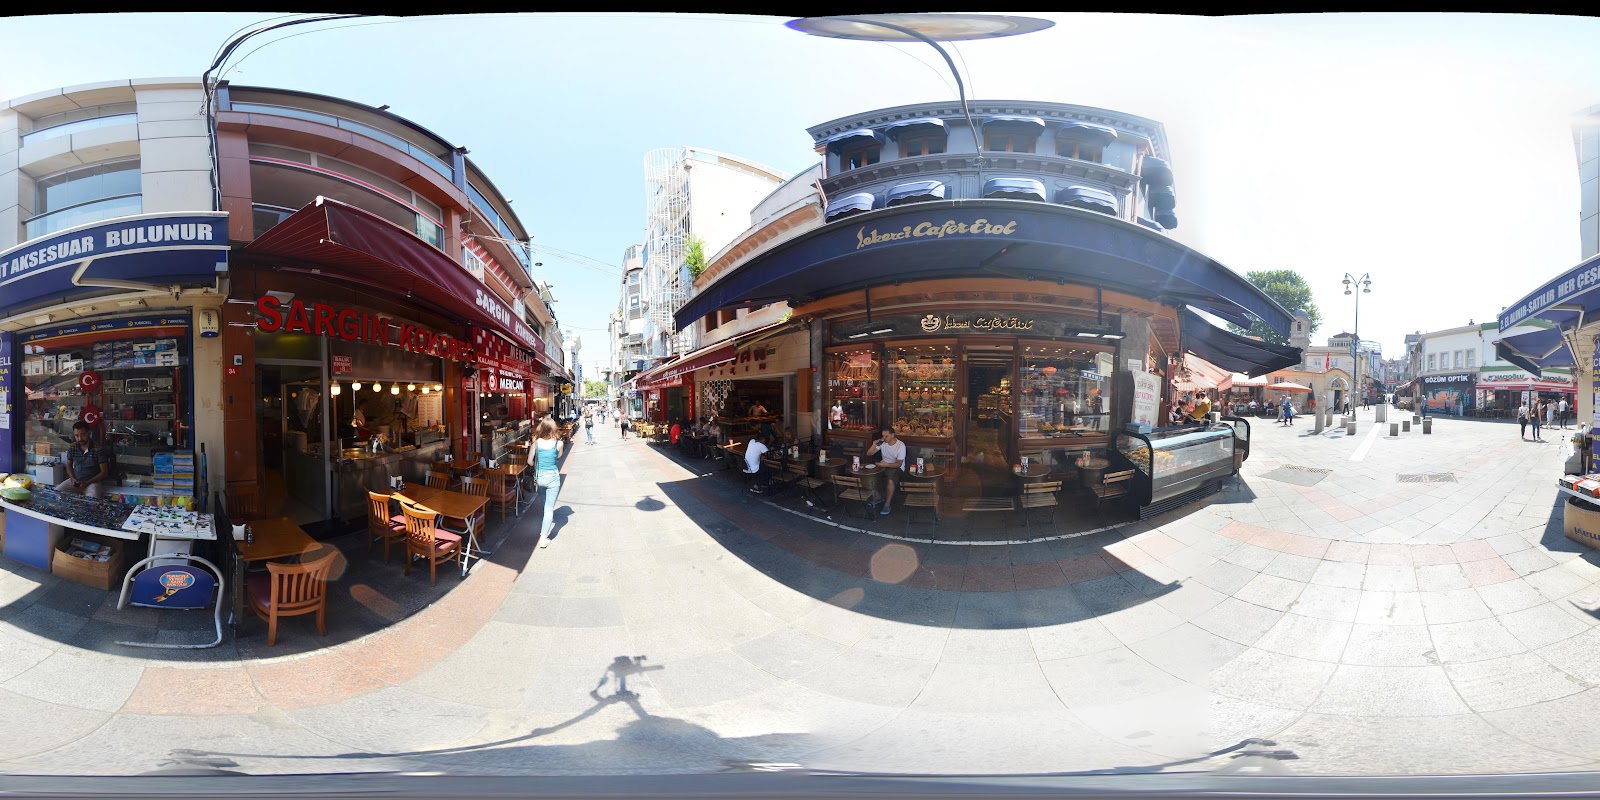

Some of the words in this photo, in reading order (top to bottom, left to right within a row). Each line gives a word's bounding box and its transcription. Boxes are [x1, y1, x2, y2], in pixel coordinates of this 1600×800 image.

[913, 219, 969, 239] Cafer
[969, 218, 1018, 235] Erol
[10, 236, 94, 274] AKSESUAR
[106, 223, 213, 248] BULUNUR
[1557, 278, 1576, 299] HER
[476, 288, 511, 327] SARGIN
[257, 295, 390, 347] SARGIN
[500, 378, 523, 392] MERCAN
[1424, 375, 1447, 384] GÖZÜM
[1448, 374, 1469, 383] OPTİK
